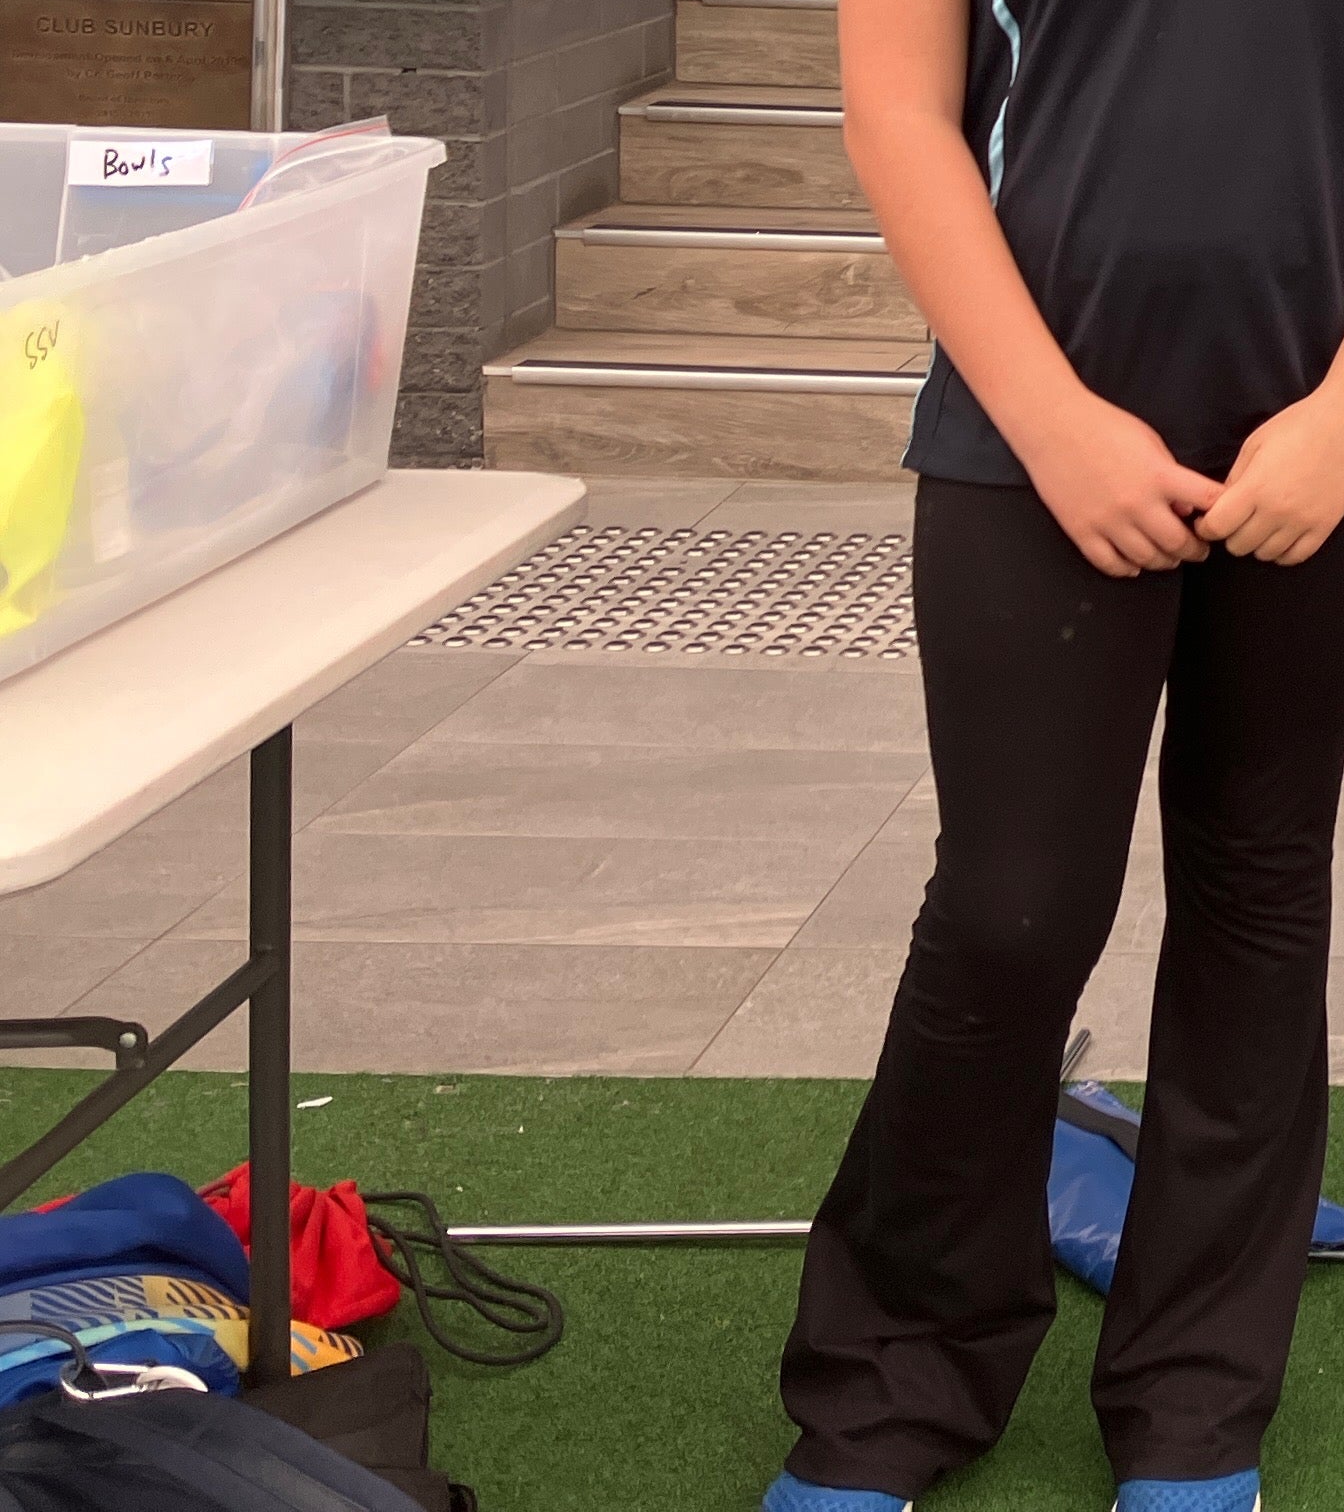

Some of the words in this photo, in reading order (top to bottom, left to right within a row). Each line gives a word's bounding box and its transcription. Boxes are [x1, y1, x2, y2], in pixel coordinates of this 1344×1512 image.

[36, 15, 97, 36] CLUB
[104, 17, 215, 39] SUNBURY
[103, 147, 173, 180] Bowls
[24, 319, 60, 369] SSV
